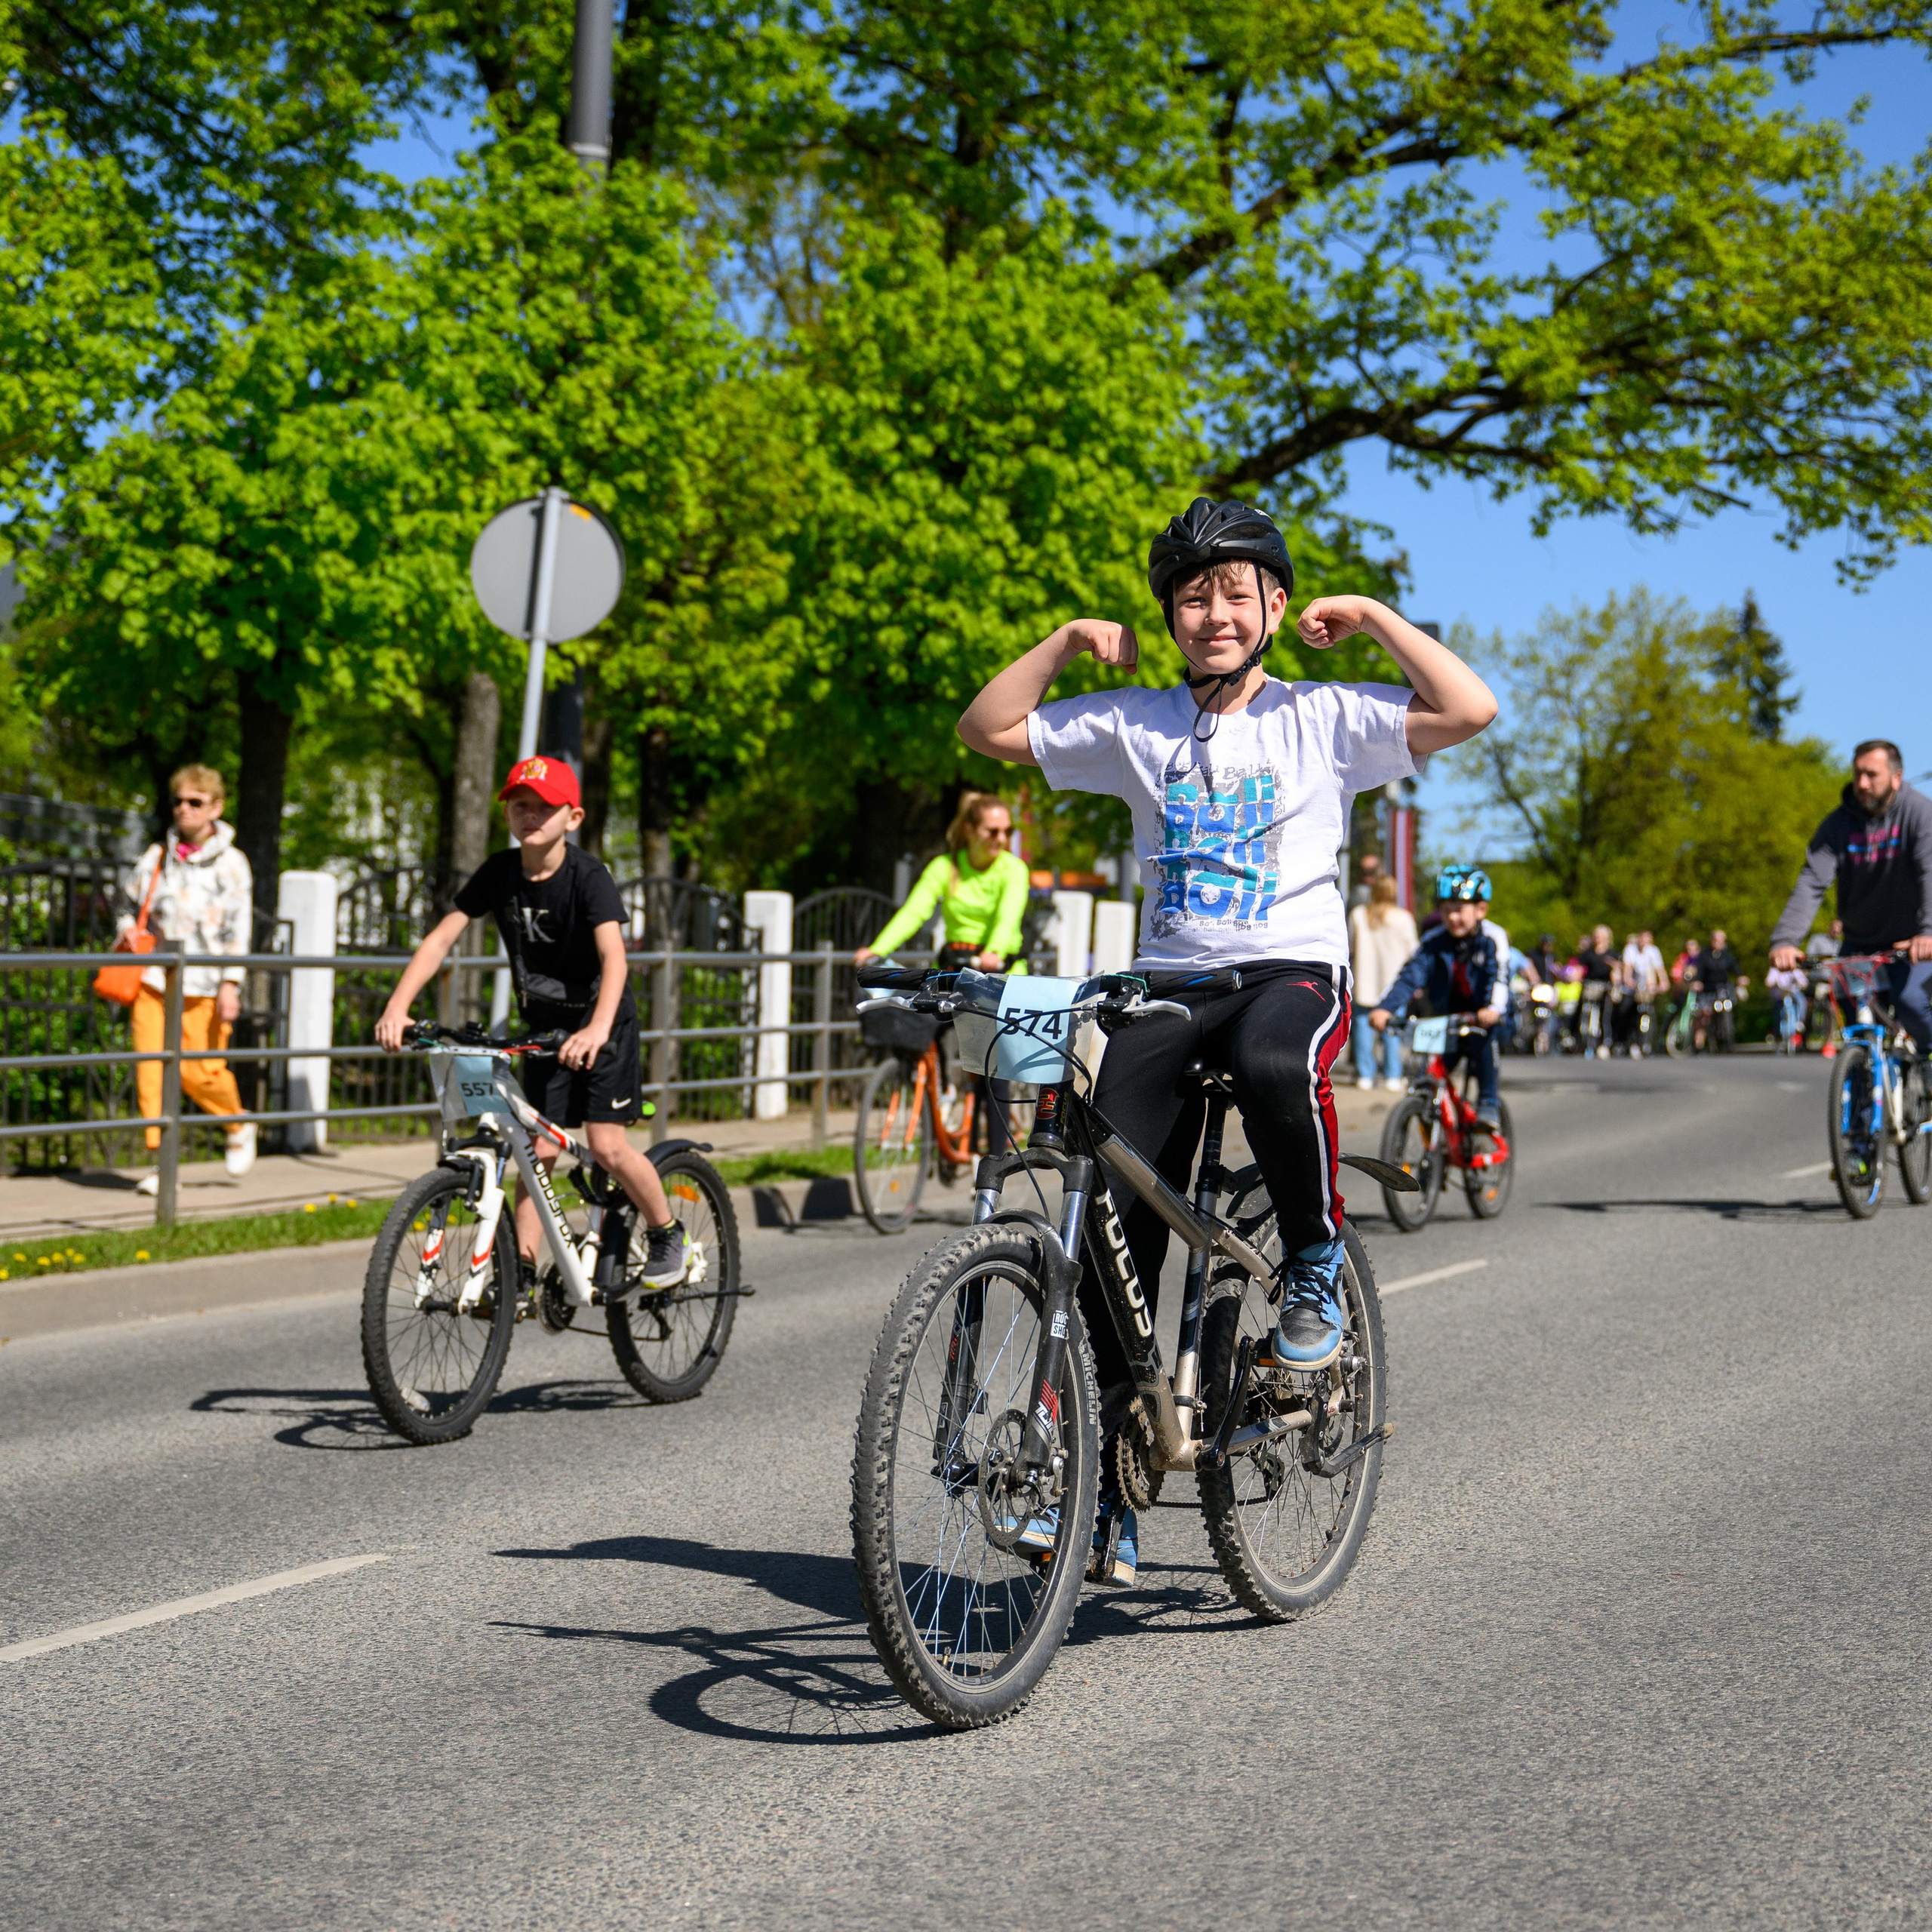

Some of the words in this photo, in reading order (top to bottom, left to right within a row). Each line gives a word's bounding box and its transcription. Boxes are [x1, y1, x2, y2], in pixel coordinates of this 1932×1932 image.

[1003, 1007, 1063, 1040] 574
[461, 1081, 494, 1097] 557
[1094, 1188, 1152, 1337] FOCUS
[1081, 1351, 1097, 1426] MICHELIN
